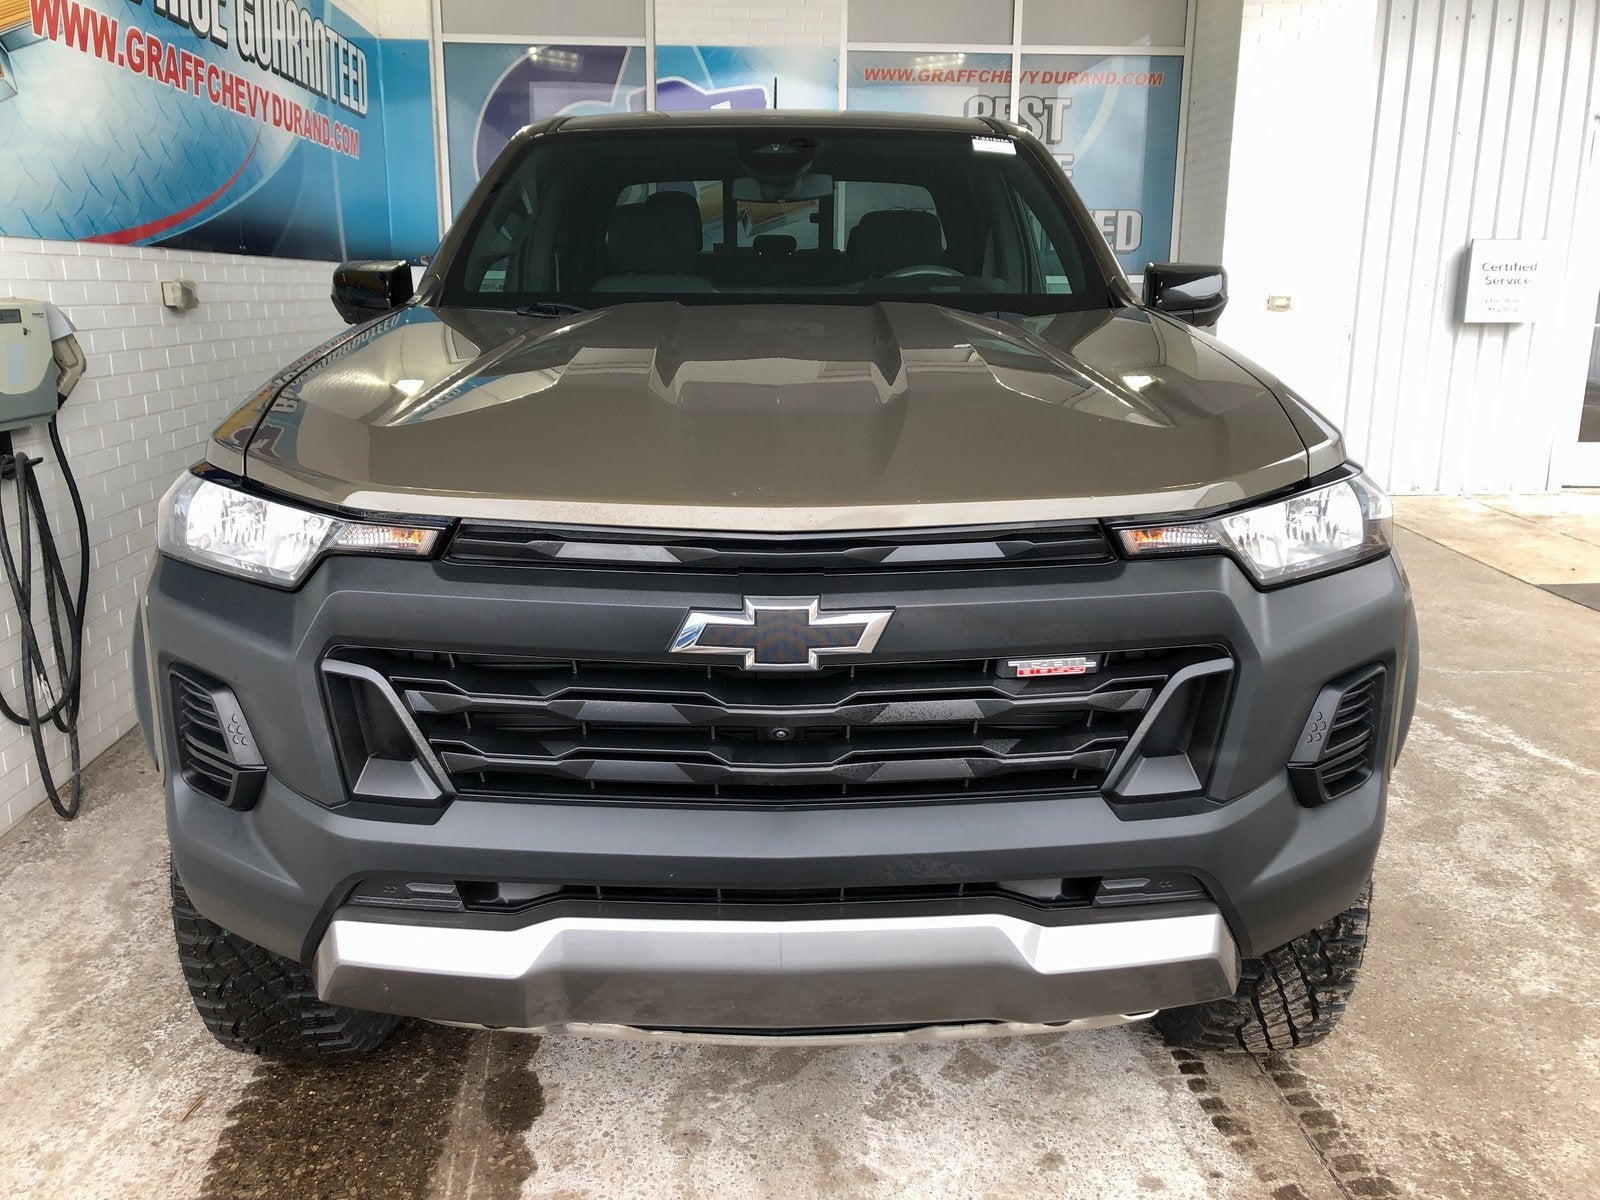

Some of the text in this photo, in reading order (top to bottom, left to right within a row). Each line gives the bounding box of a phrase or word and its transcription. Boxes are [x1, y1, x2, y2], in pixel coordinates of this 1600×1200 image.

[29, 0, 359, 159] WWW.GRAFFCHEVYDURAND.COM
[236, 0, 368, 118] GUARANTEED
[1482, 261, 1538, 272] Certified
[1485, 275, 1531, 285] Service
